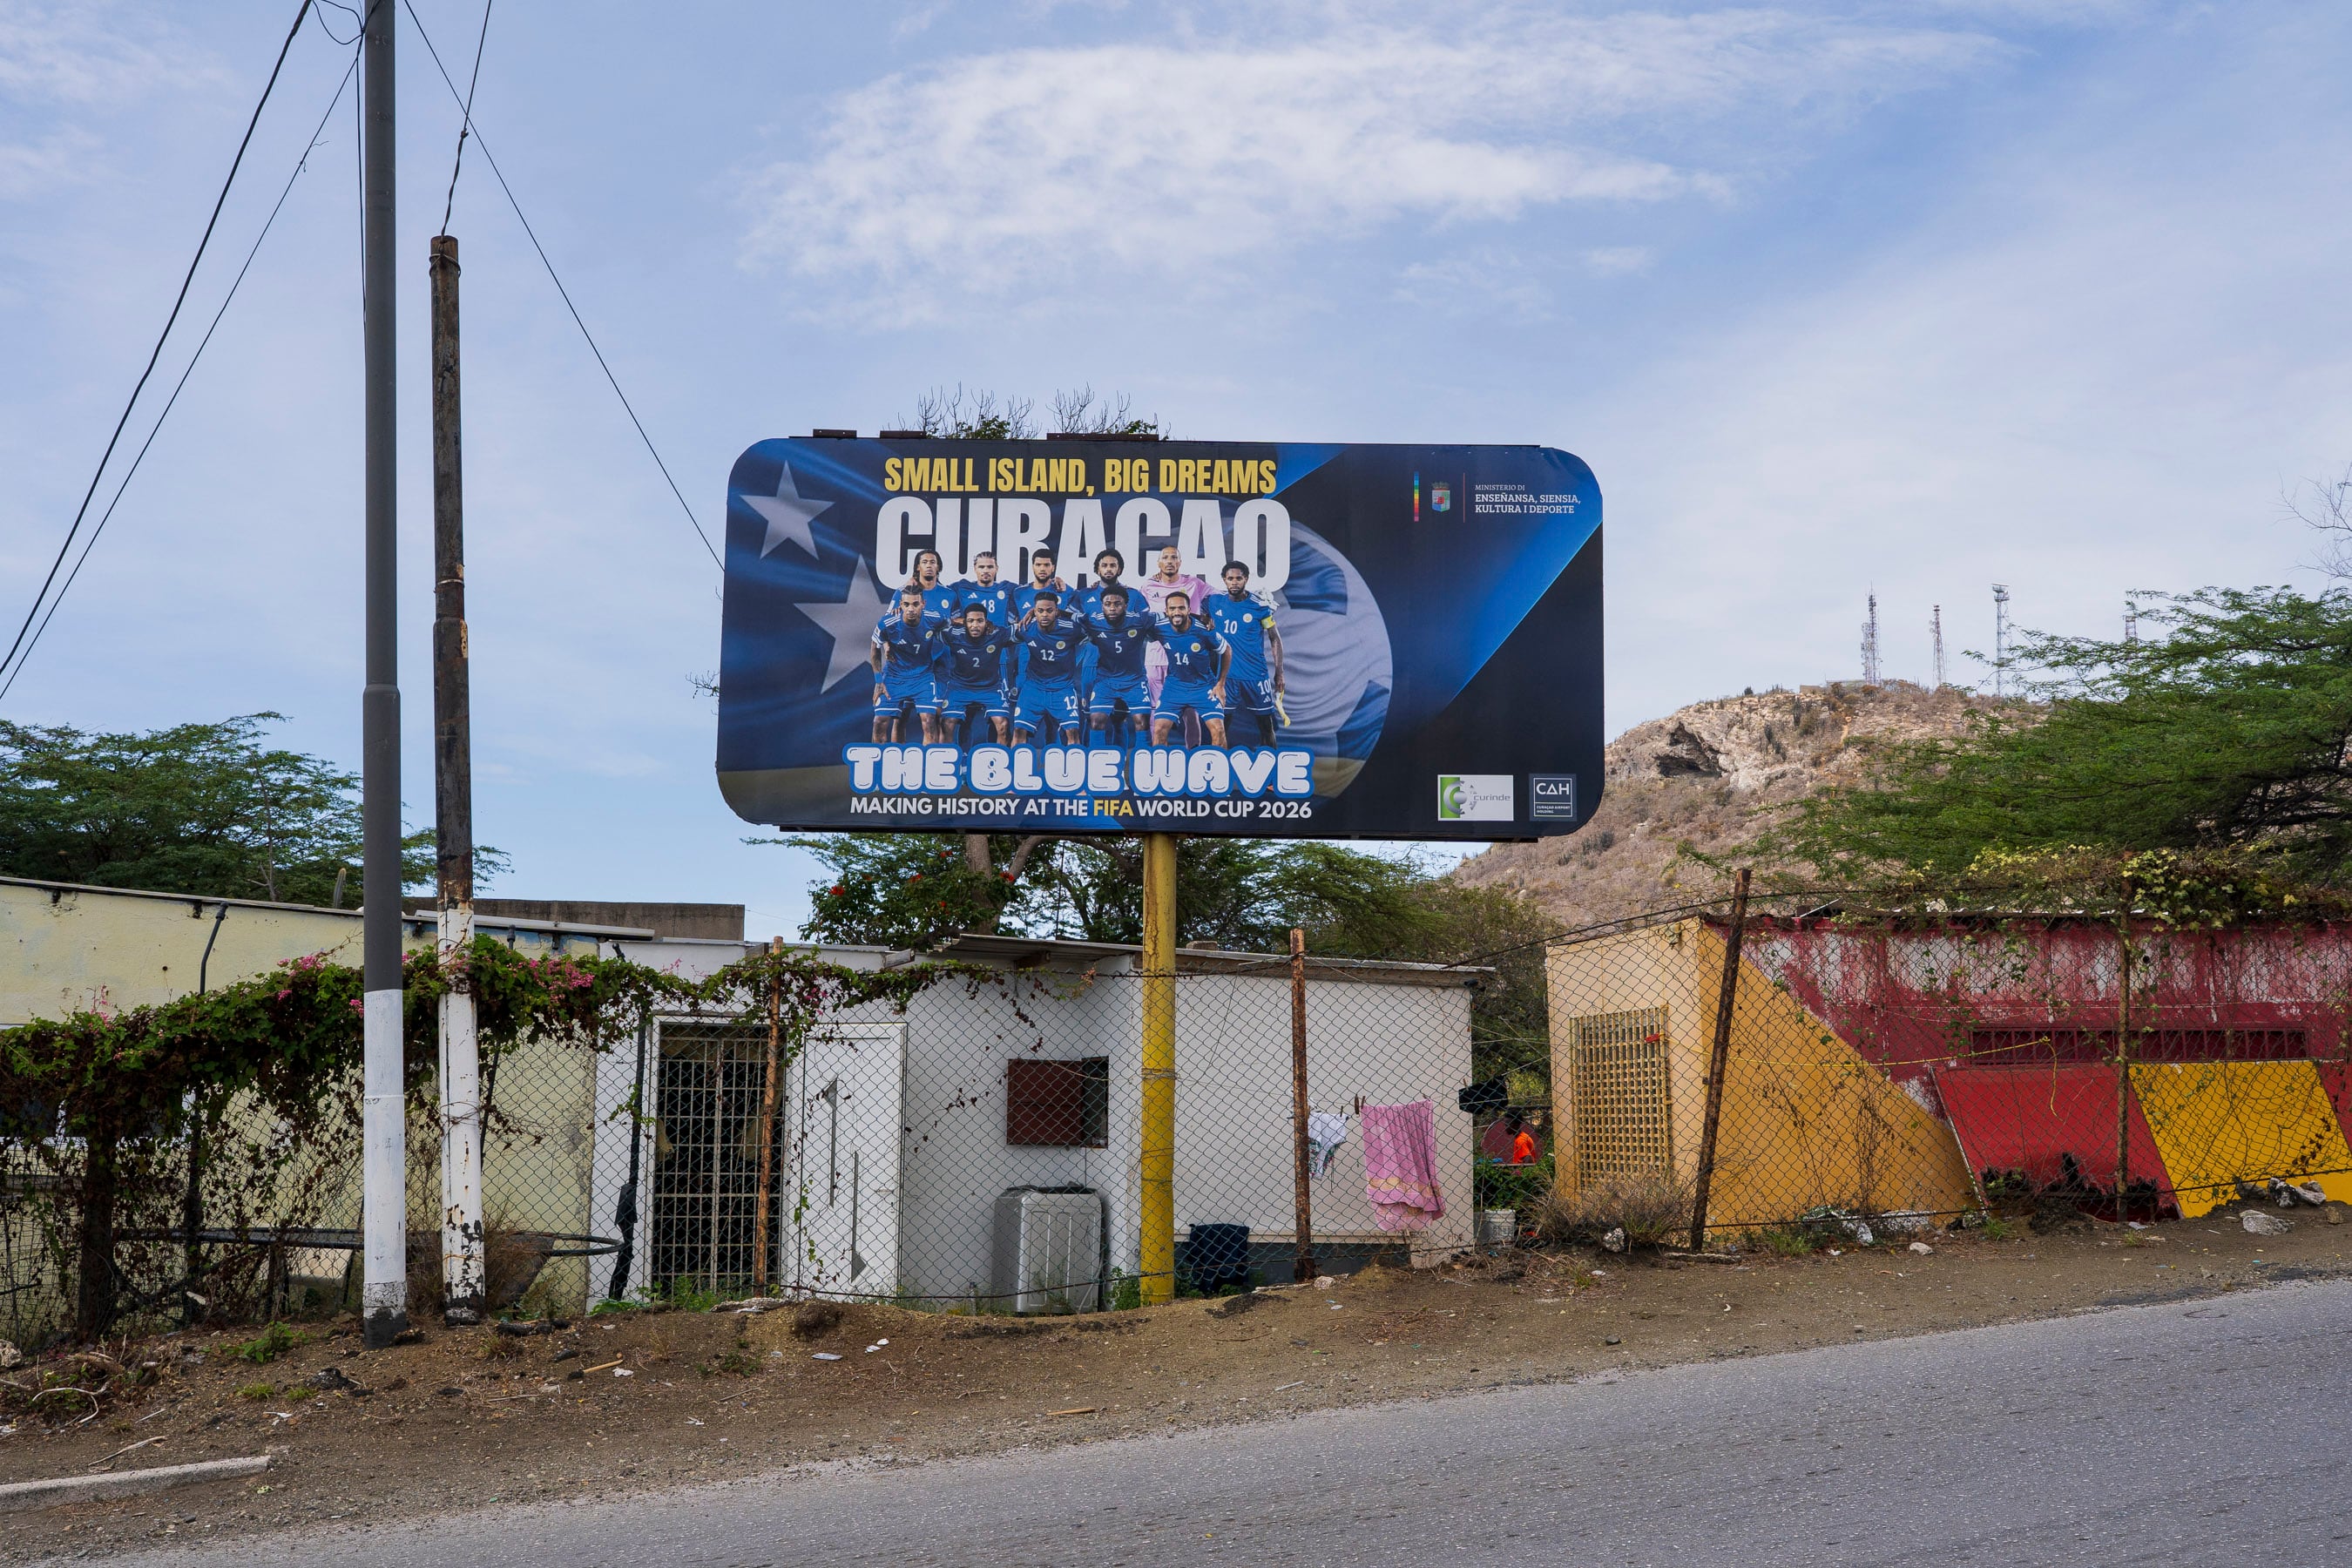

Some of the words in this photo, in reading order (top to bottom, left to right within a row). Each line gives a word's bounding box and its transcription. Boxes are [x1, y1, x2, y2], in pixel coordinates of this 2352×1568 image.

[884, 457, 979, 492] SMALL
[989, 457, 1094, 497] ISLAND,
[1105, 458, 1149, 492] BIG
[1159, 459, 1276, 494] DREAMS
[1475, 492, 1538, 504] ENSEÑANSA,
[1539, 495, 1581, 504] SIENSIA,
[1529, 505, 1574, 514] DEPORTE
[1224, 619, 1238, 634] 10
[914, 644, 921, 653] 7
[1115, 640, 1122, 653] 5
[1040, 649, 1055, 661] 12
[1174, 652, 1190, 666] 14
[972, 658, 980, 667] 2
[1140, 682, 1149, 694] 5
[846, 747, 958, 791] THE
[970, 747, 1121, 794] BLUE
[1132, 748, 1311, 795] WAVE
[1536, 782, 1570, 795] CAH
[850, 797, 933, 815] MAKING
[937, 799, 1020, 816] HISTORY
[1024, 799, 1051, 816] AT
[1053, 800, 1088, 816] THE
[1093, 801, 1134, 817] FIFA
[1137, 801, 1214, 817] WORLD
[1218, 801, 1254, 818] CUP
[1259, 801, 1312, 819] 2026
